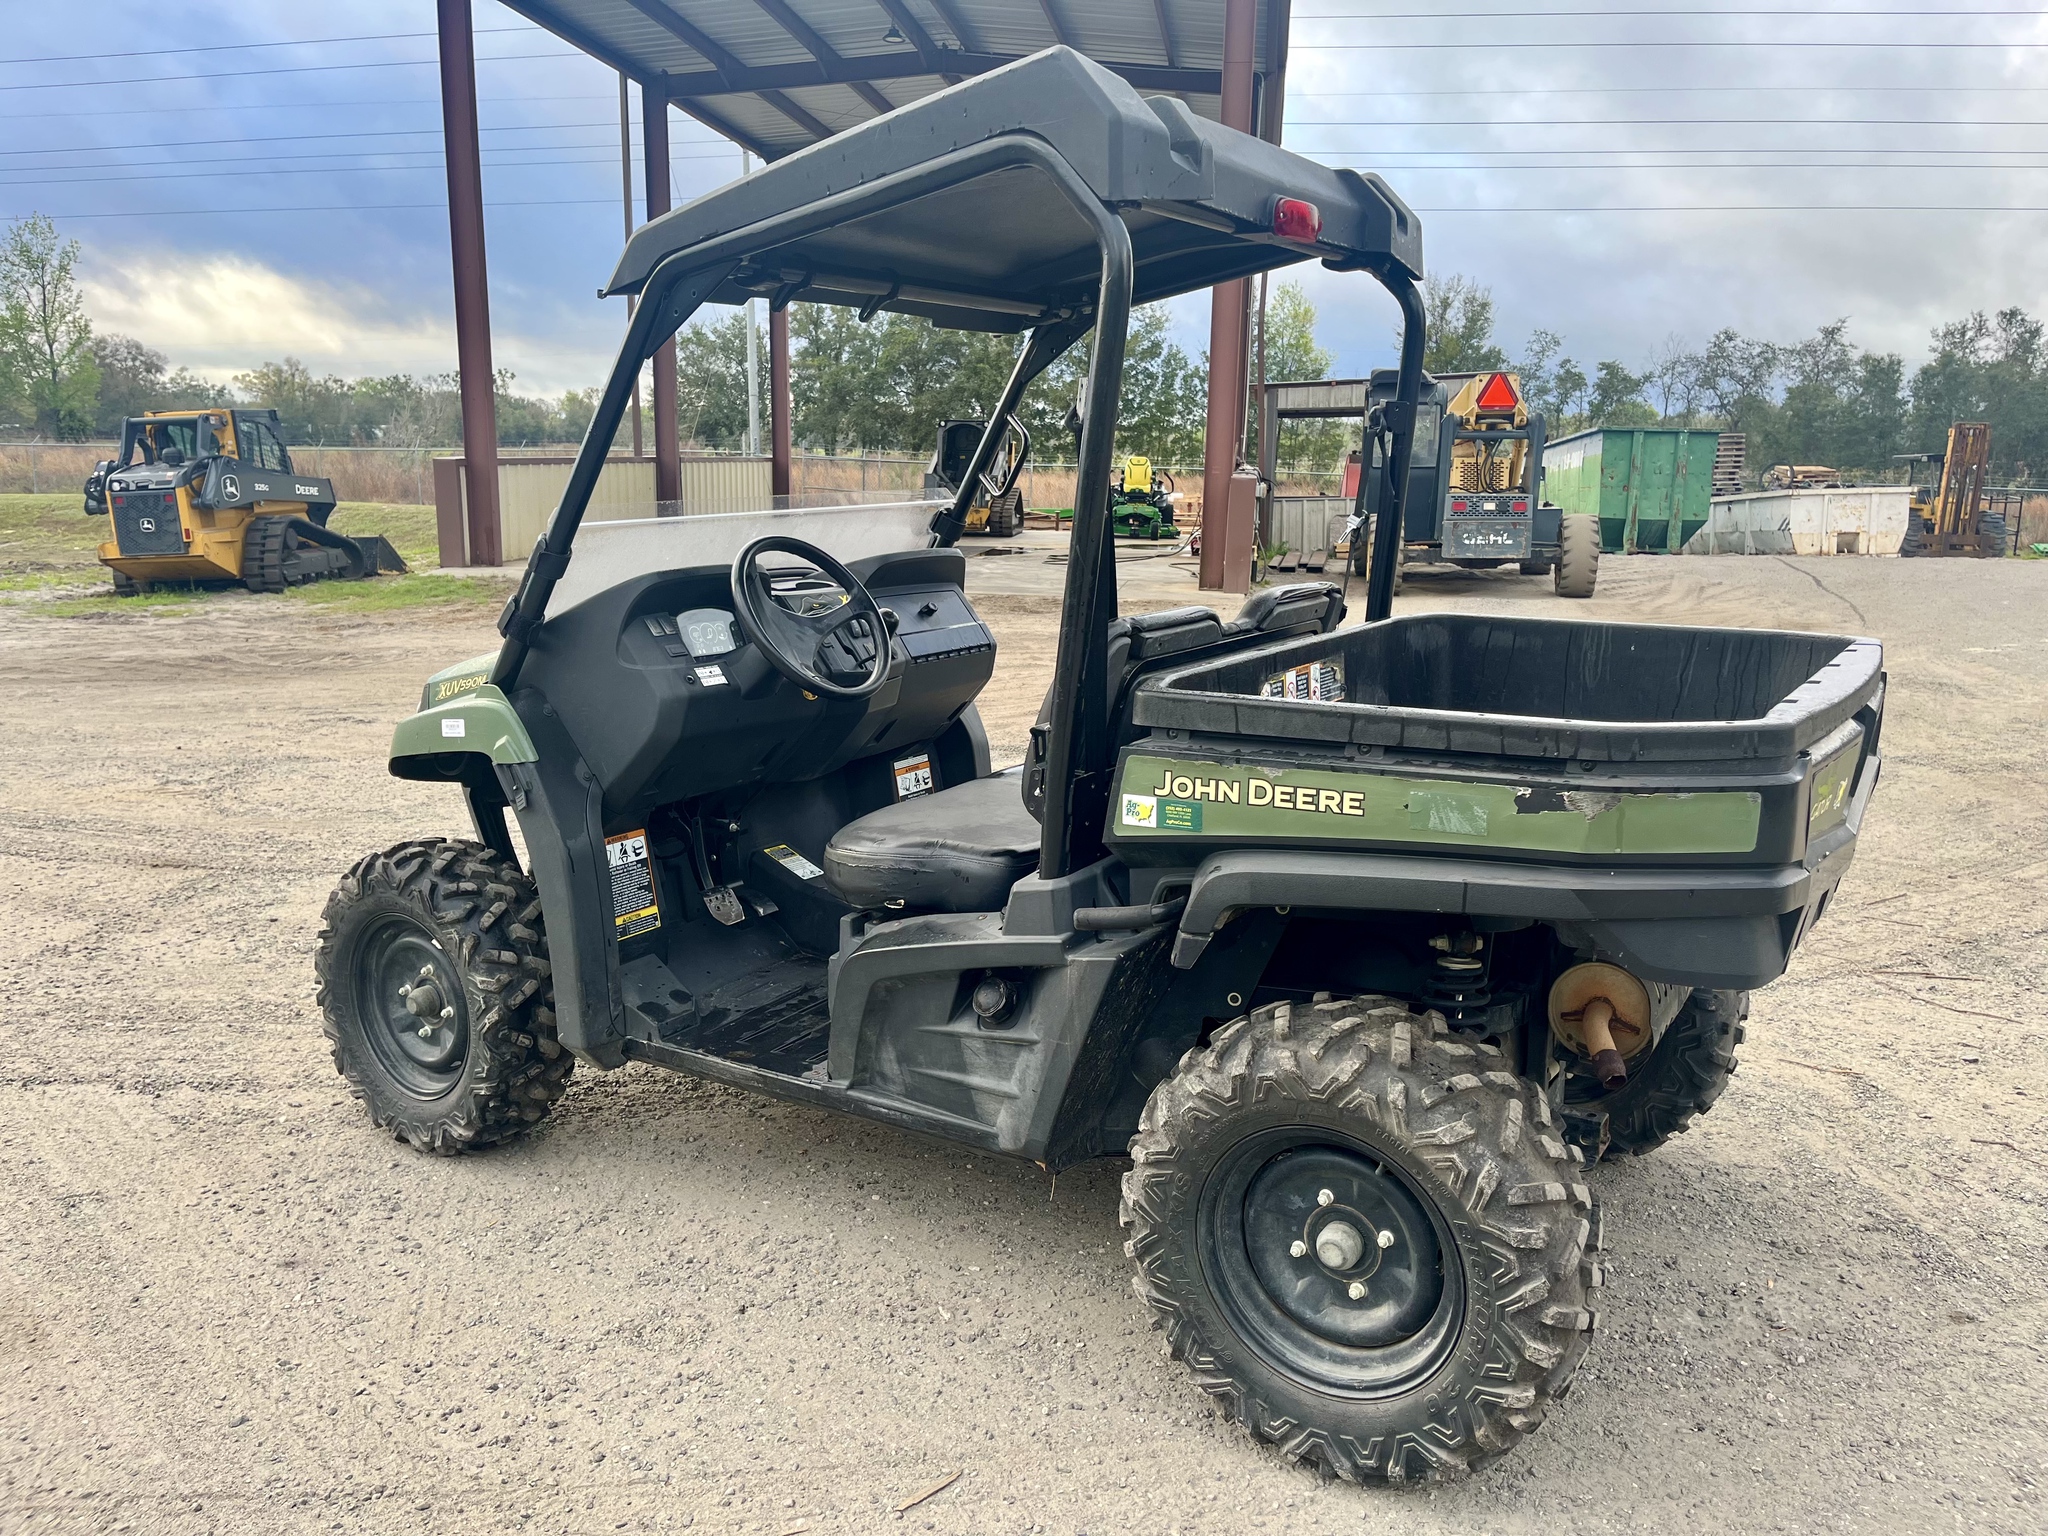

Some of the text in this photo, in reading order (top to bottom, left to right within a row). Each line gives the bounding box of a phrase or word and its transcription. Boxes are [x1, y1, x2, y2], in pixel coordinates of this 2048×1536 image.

[295, 484, 319, 495] DEERE
[1153, 770, 1365, 816] JOHN DEERE
[1126, 808, 1140, 817] Pro
